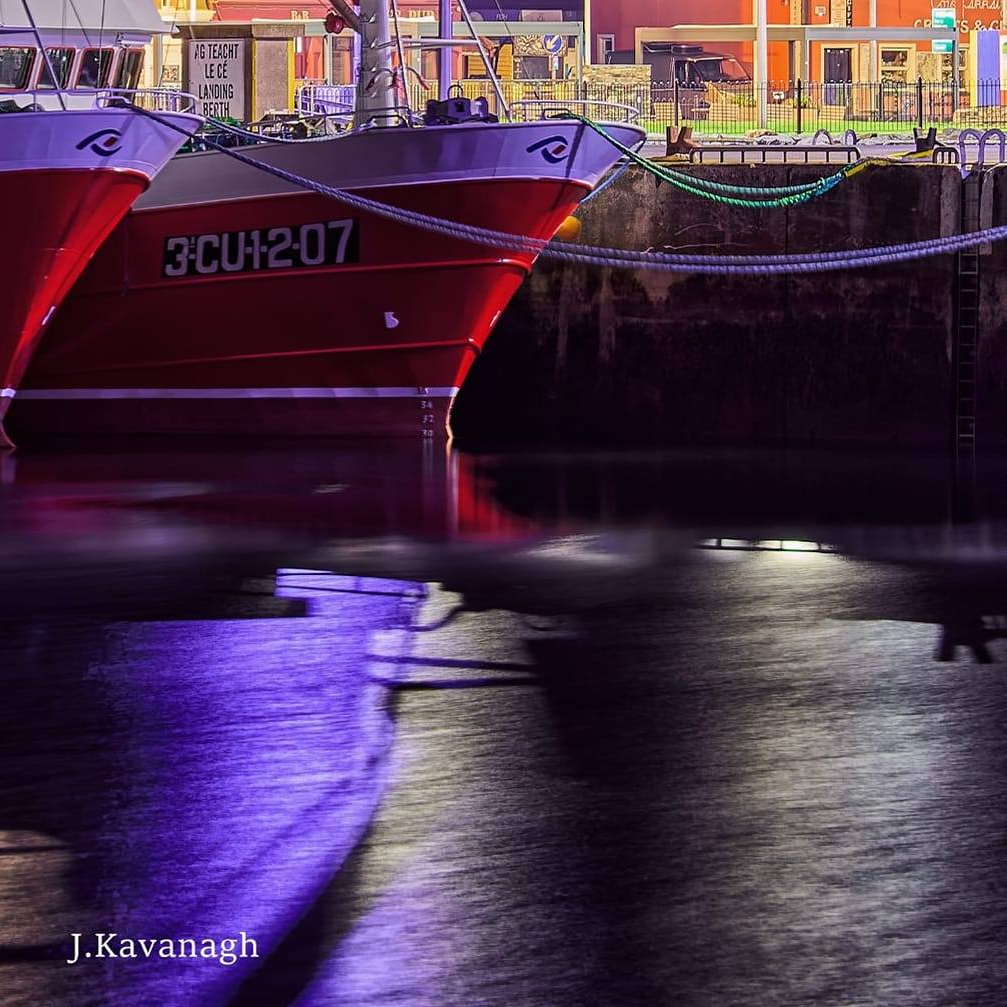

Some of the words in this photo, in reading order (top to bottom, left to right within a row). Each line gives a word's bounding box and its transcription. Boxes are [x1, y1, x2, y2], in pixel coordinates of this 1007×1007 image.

[194, 43, 205, 59] AG
[208, 43, 239, 59] TEACHT
[205, 64, 215, 79] LE
[217, 60, 228, 79] CÉ
[199, 84, 234, 99] LANDING
[203, 102, 230, 118] BERTH
